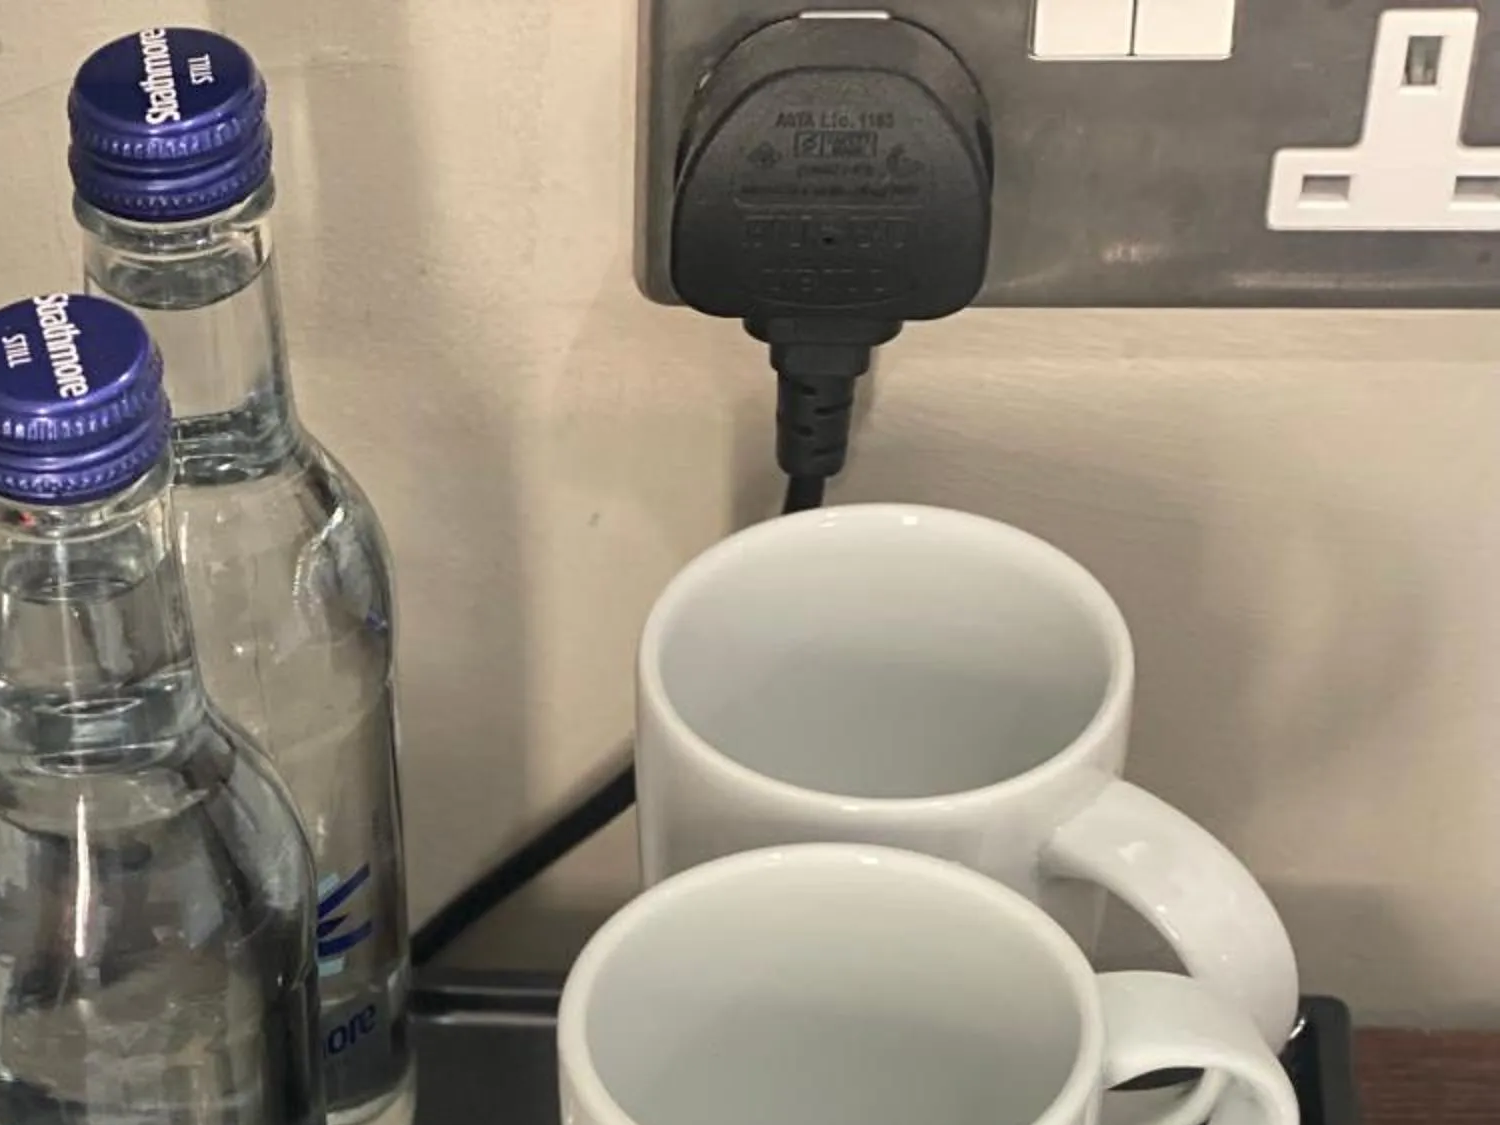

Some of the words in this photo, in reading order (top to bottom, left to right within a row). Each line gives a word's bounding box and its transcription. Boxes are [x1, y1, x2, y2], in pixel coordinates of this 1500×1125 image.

[139, 28, 180, 124] Strathmore
[187, 53, 214, 85] STILL
[2, 333, 32, 368] STILL
[34, 293, 88, 398] Strathmore
